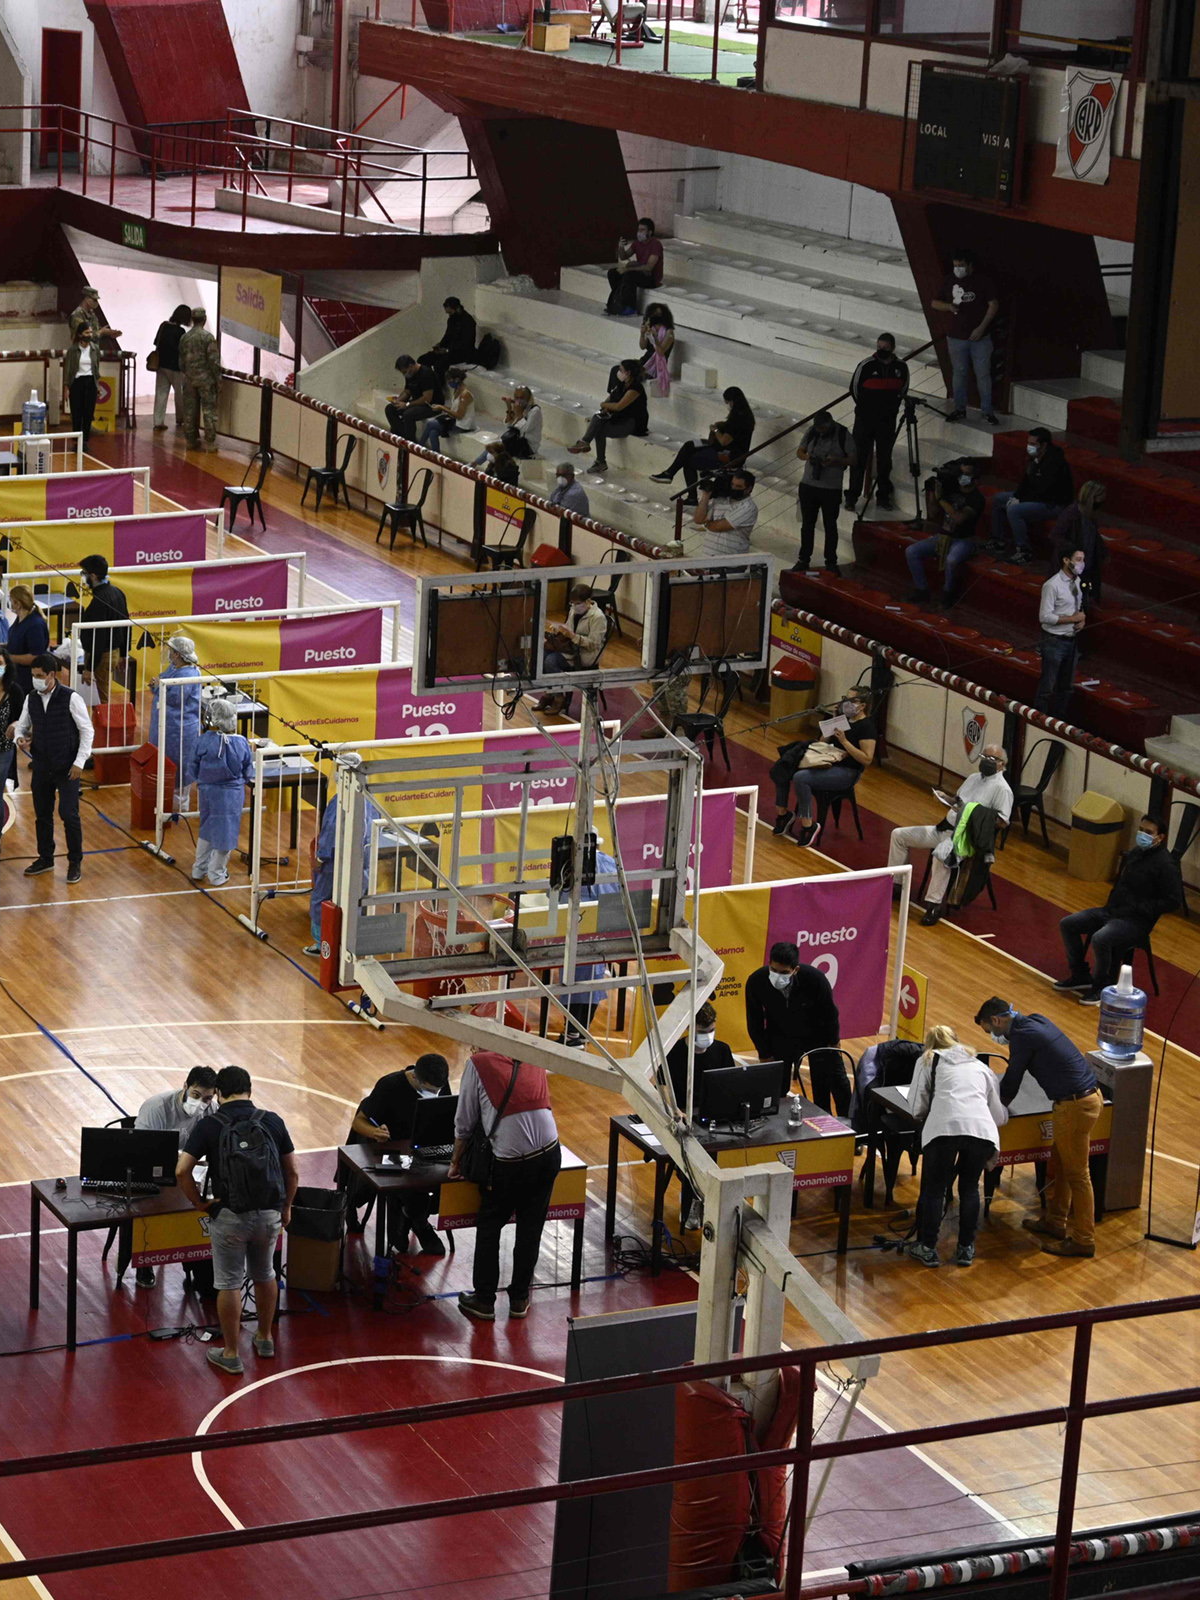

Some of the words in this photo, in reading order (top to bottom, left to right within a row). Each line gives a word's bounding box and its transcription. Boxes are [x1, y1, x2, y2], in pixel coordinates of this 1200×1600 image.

[920, 123, 947, 138] LOCAL
[982, 134, 1010, 148] VISIA
[124, 224, 144, 246] SALIDA
[236, 283, 264, 311] Salida
[68, 506, 112, 518] Puesto
[136, 550, 182, 563] Puesto
[216, 596, 264, 610] Puesto
[304, 647, 356, 662] Puesto
[402, 702, 456, 718] Puesto
[797, 926, 858, 947] Puesto
[718, 990, 739, 998] Aires
[1014, 1151, 1025, 1162] de
[444, 1216, 474, 1228] Sector
[138, 1254, 170, 1264] Sector
[172, 1251, 185, 1260] de
